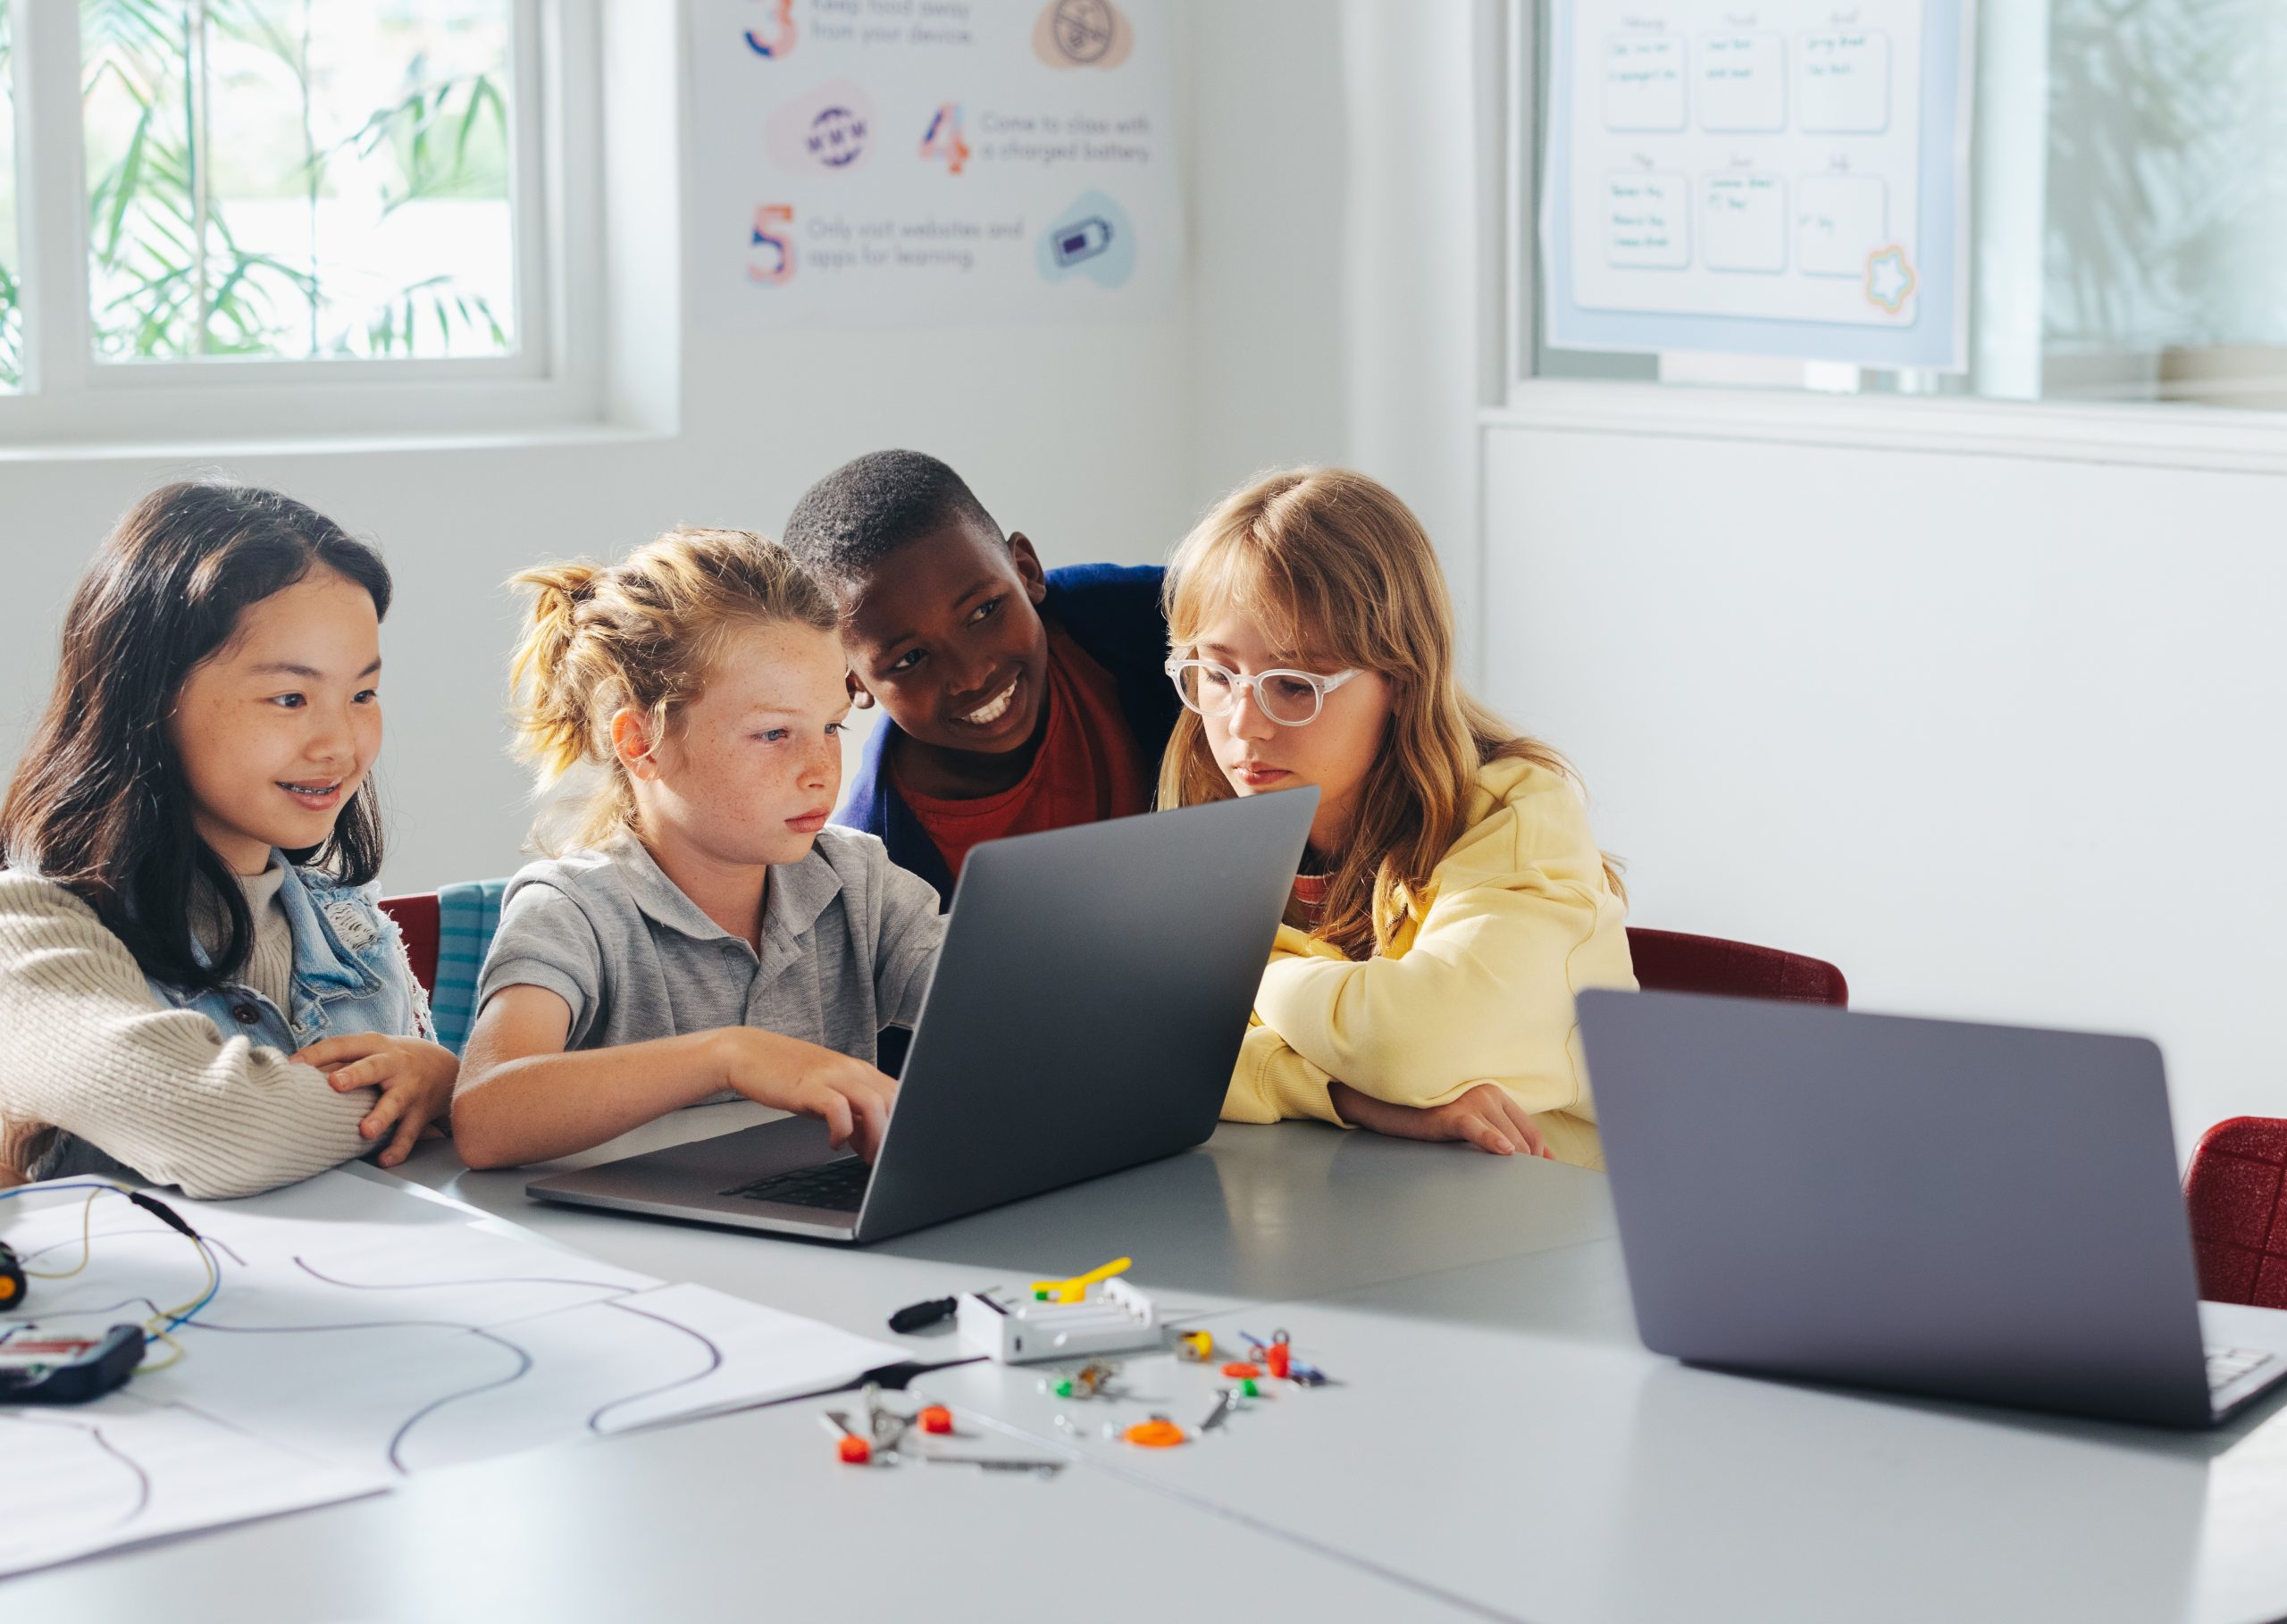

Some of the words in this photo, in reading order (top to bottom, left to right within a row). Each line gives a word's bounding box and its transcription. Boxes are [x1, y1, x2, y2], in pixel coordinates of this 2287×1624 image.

[744, 0, 799, 59] 3
[810, 15, 853, 40] from
[860, 24, 901, 47] your
[919, 101, 970, 174] 4
[979, 111, 1035, 134] Come
[1041, 113, 1060, 134] to
[1065, 110, 1110, 135] class
[1114, 109, 1152, 134] with
[979, 142, 996, 161] a
[999, 137, 1078, 167] charged
[806, 215, 852, 243] Only
[859, 216, 895, 240] visit
[901, 213, 982, 240] websites
[988, 213, 1026, 240] and
[747, 205, 795, 285] 5
[808, 248, 857, 274] apps
[861, 242, 890, 266] for
